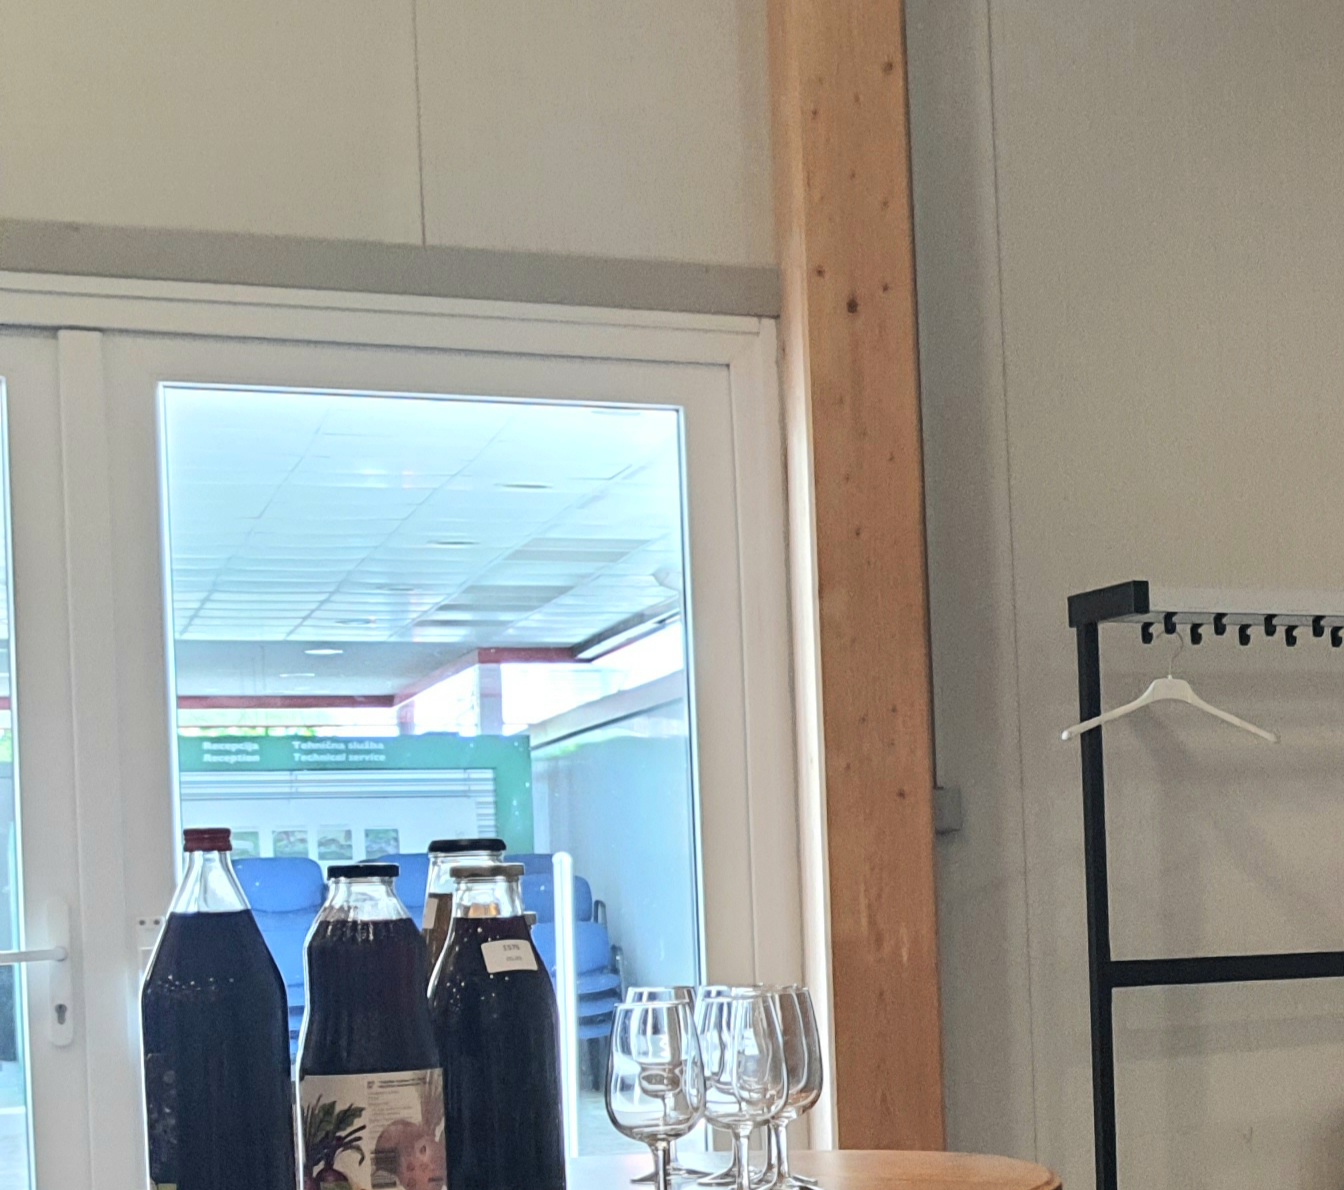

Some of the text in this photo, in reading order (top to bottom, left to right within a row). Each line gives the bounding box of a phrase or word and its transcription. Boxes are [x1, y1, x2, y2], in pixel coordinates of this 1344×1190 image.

[202, 741, 260, 752] Recepcija
[292, 740, 385, 750] Tehnična služba
[203, 753, 261, 763] Reception
[293, 753, 386, 762] Technical service
